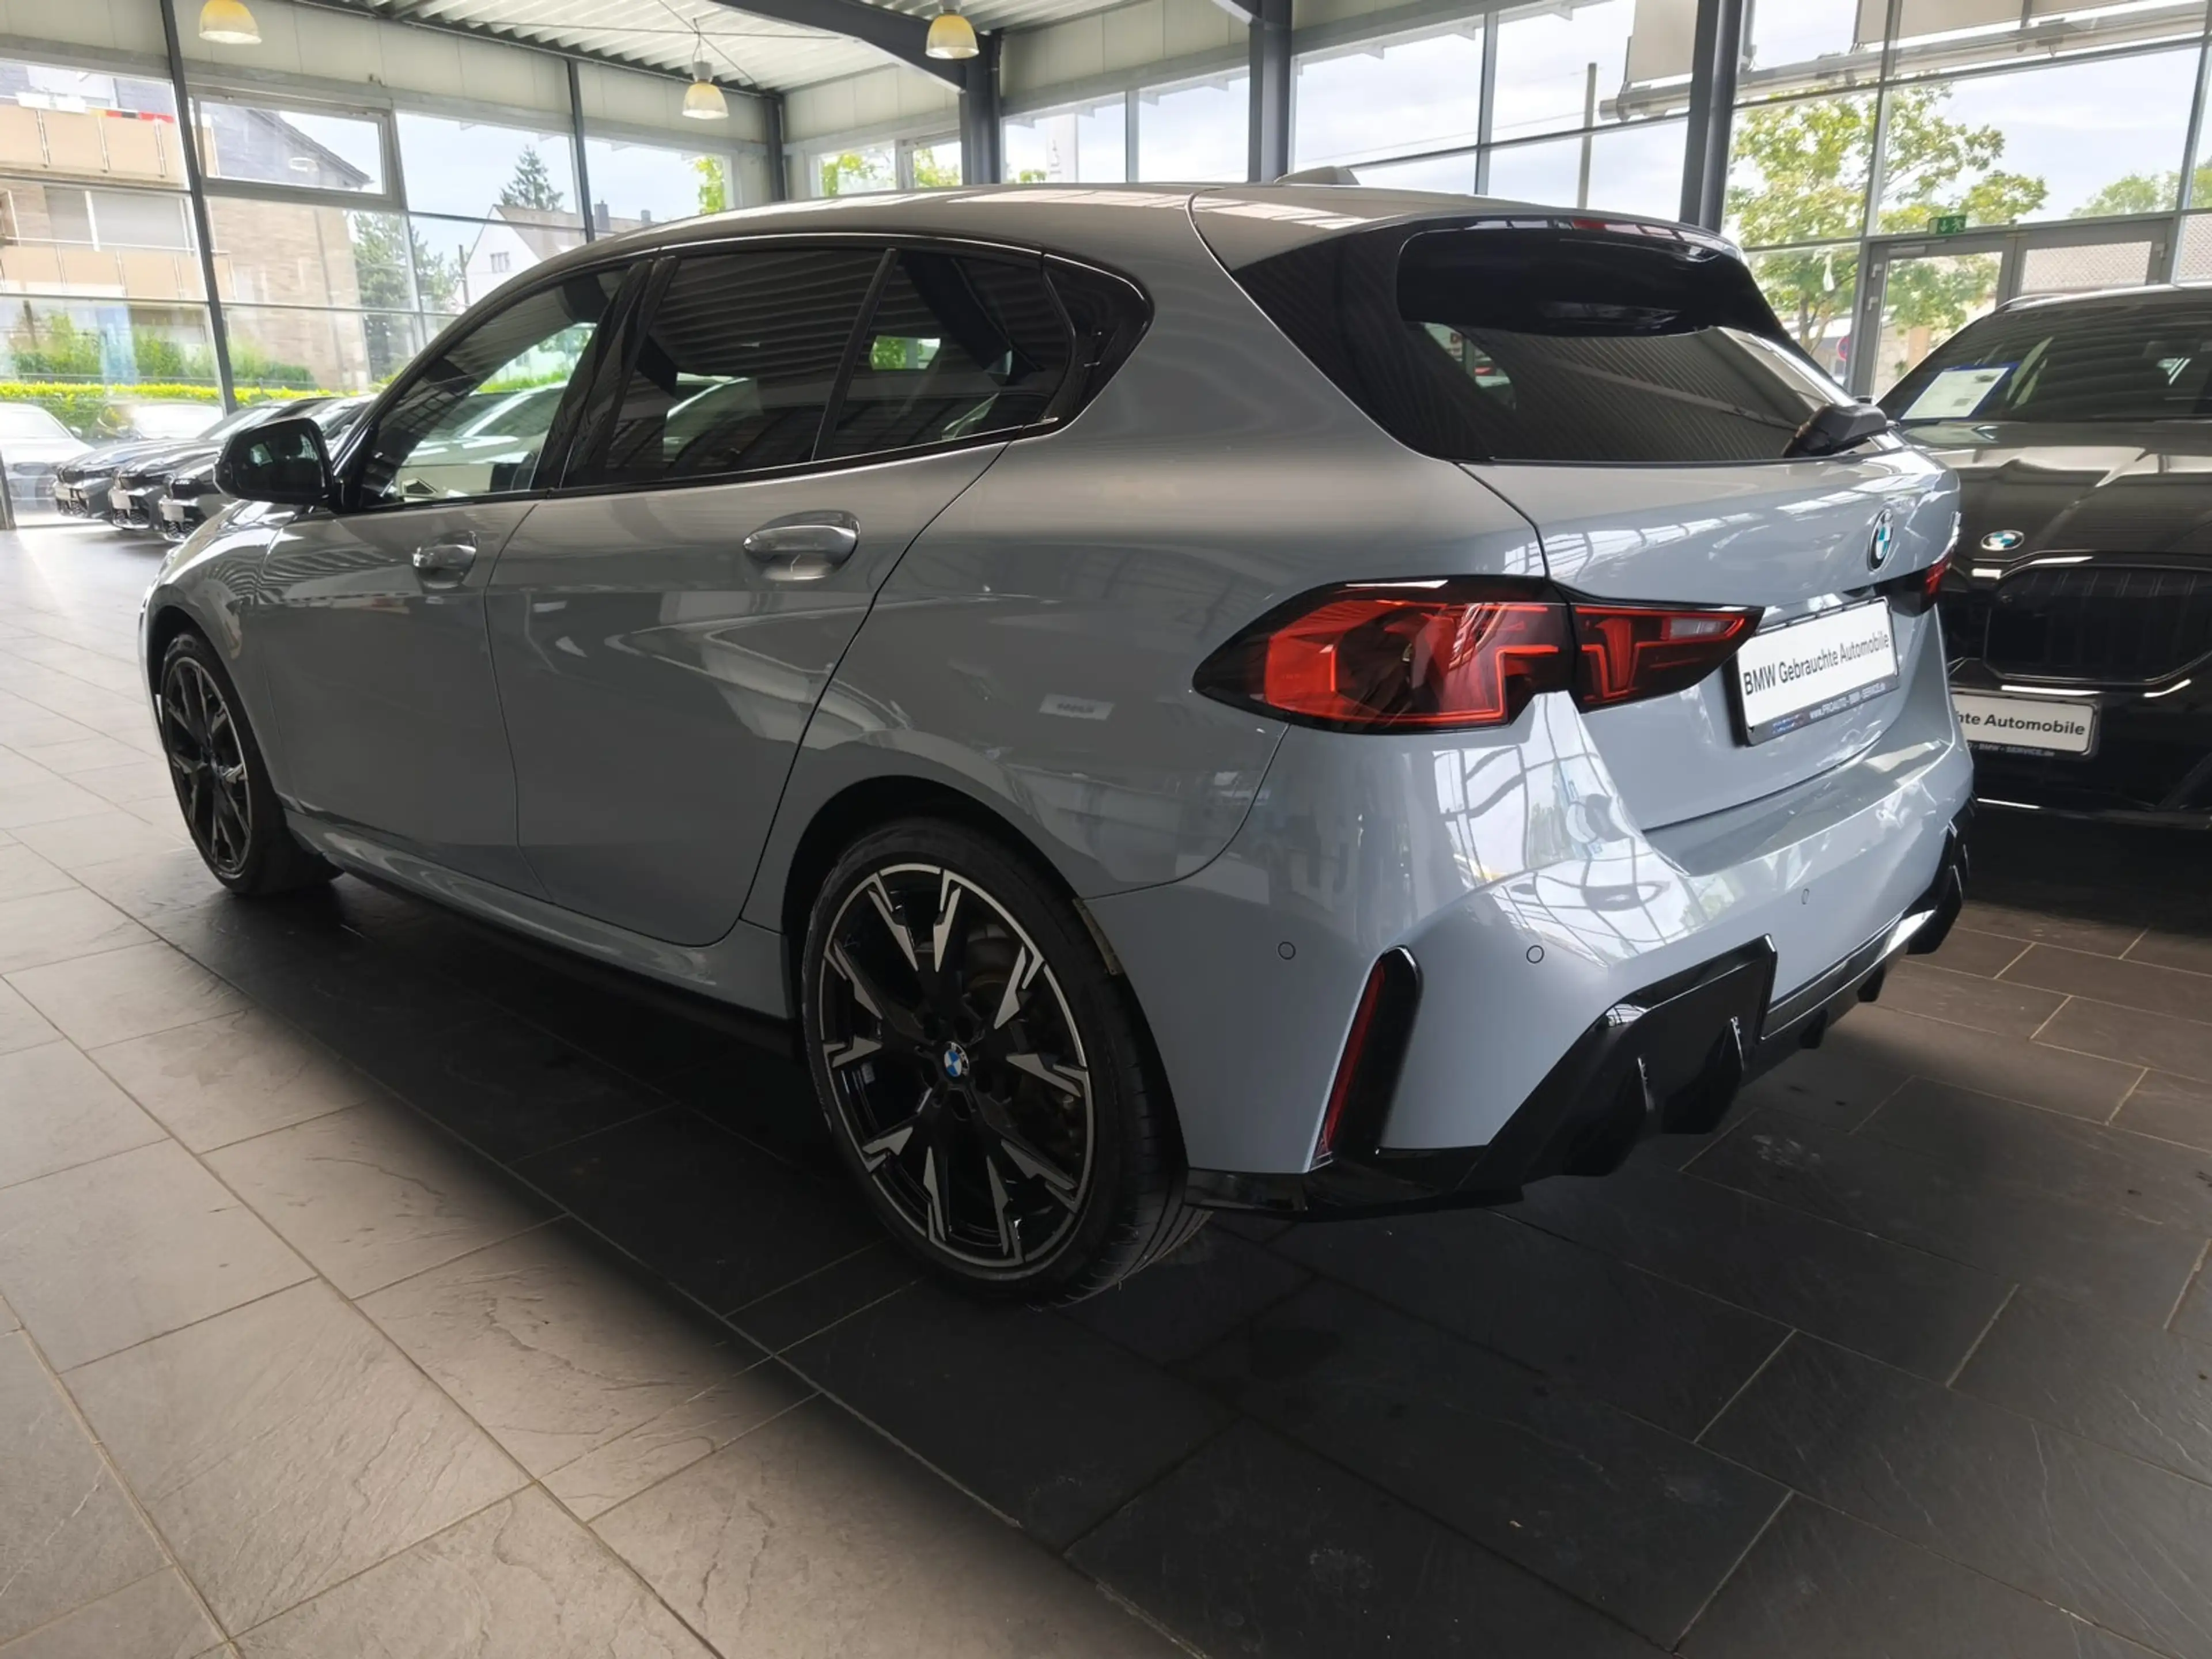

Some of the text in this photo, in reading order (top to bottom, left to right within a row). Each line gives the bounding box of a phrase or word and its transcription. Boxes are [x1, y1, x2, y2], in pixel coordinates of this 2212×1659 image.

[1743, 631, 1889, 695] BMW Gebrauchte Automobile
[1983, 714, 2085, 735] Automobile
